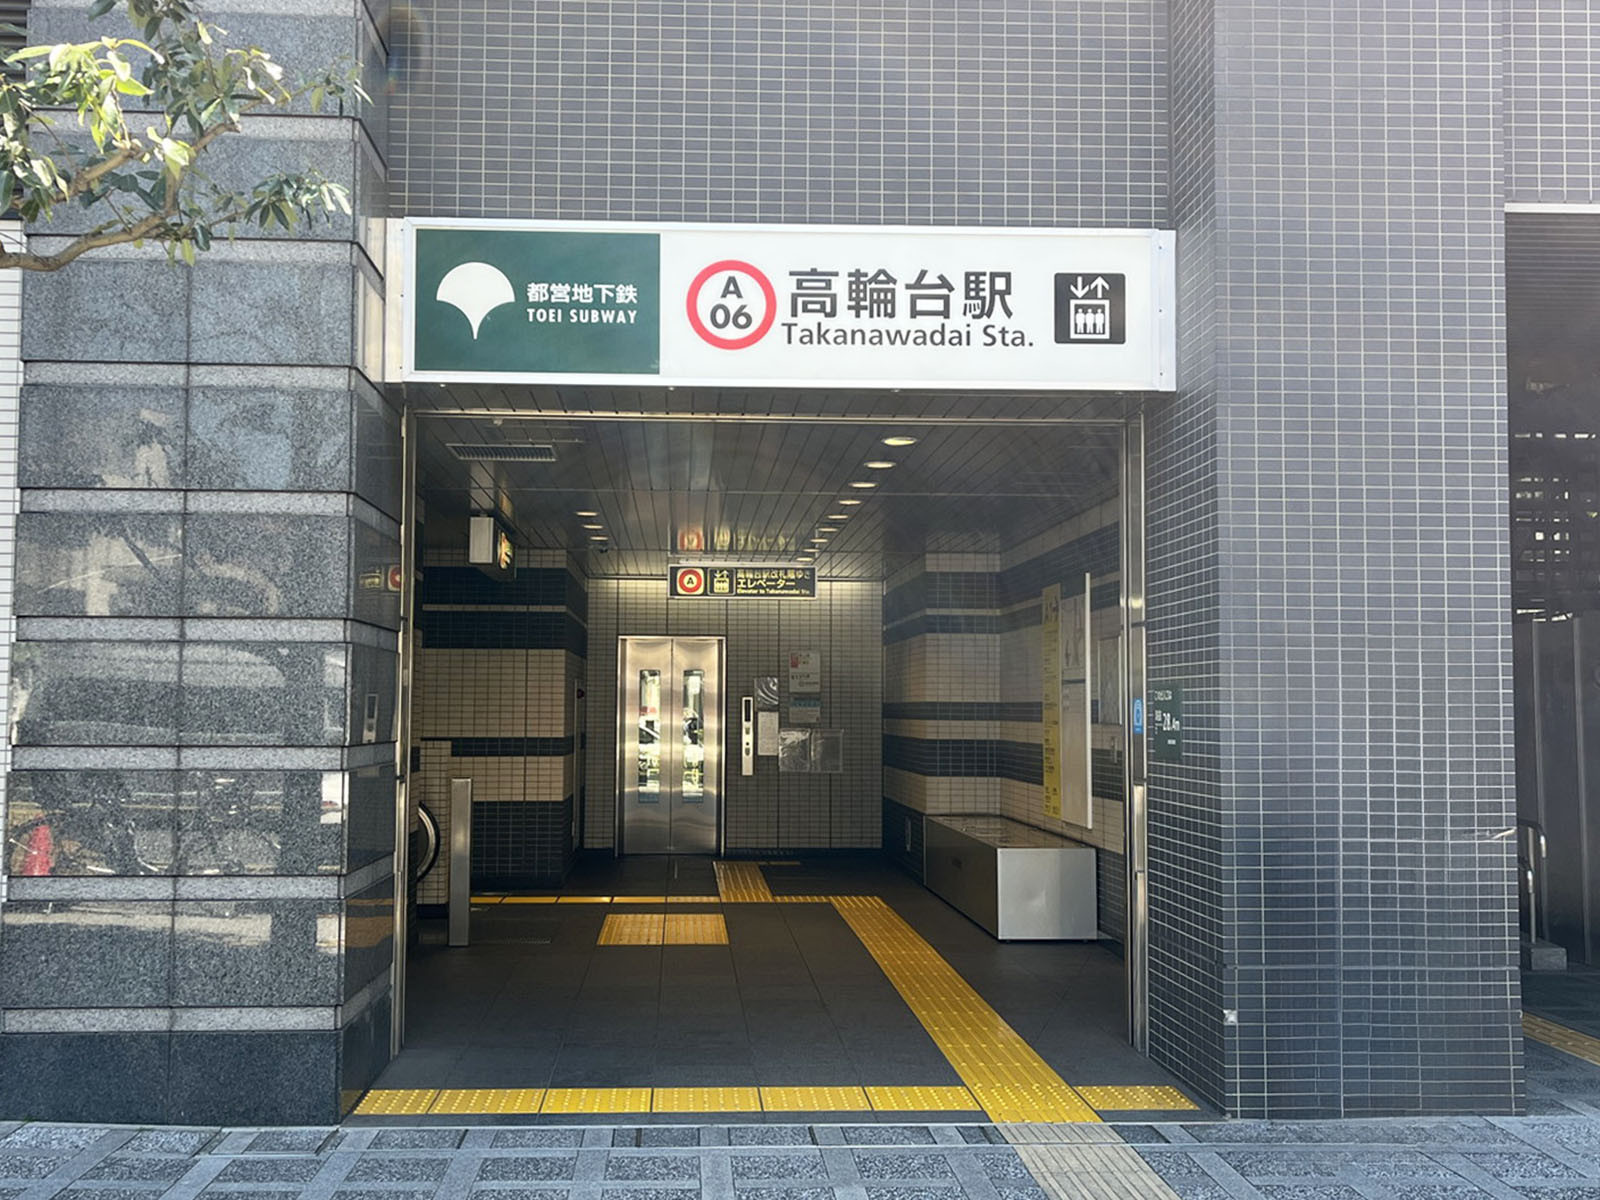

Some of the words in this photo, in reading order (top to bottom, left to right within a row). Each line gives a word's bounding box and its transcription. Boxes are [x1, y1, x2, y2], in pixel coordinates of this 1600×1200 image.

[526, 282, 639, 304] 都営地下鉄
[720, 275, 743, 299] A
[788, 267, 1014, 320] 高輪台駅
[526, 308, 563, 323] TOEI
[569, 308, 638, 324] SUBWAY
[709, 303, 753, 330] 06
[780, 322, 971, 348] Takanawadai
[982, 323, 1035, 348] Sta.
[686, 576, 695, 585] A
[736, 578, 796, 589] エレベーター
